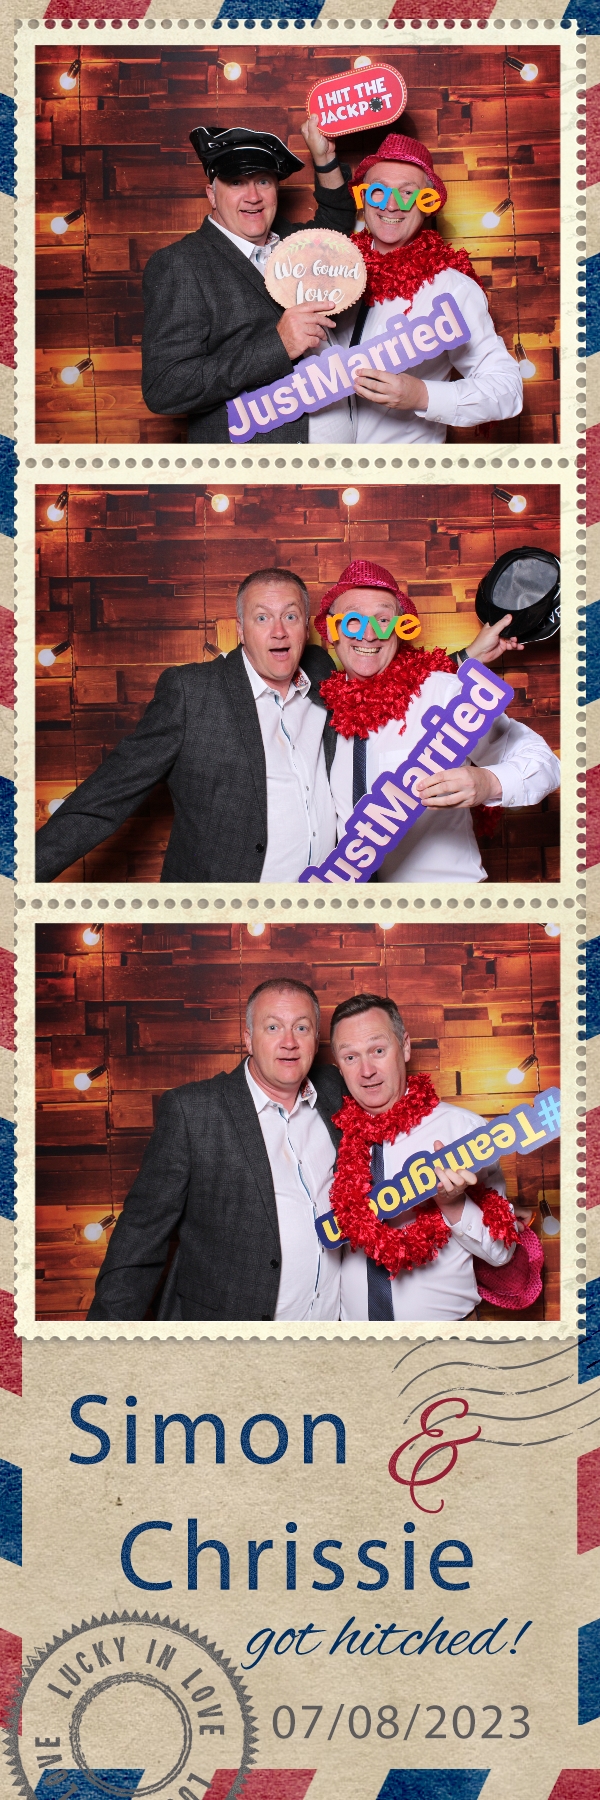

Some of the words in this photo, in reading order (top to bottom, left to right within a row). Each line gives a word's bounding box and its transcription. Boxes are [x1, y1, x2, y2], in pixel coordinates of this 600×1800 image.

[318, 95, 324, 109] I
[325, 87, 351, 106] HIT
[354, 77, 386, 98] THE
[320, 93, 392, 126] JACKPOT
[352, 182, 441, 213] rave
[274, 254, 307, 280] We
[296, 280, 345, 305] love
[326, 611, 422, 642] rave
[307, 667, 506, 883] ustMarried
